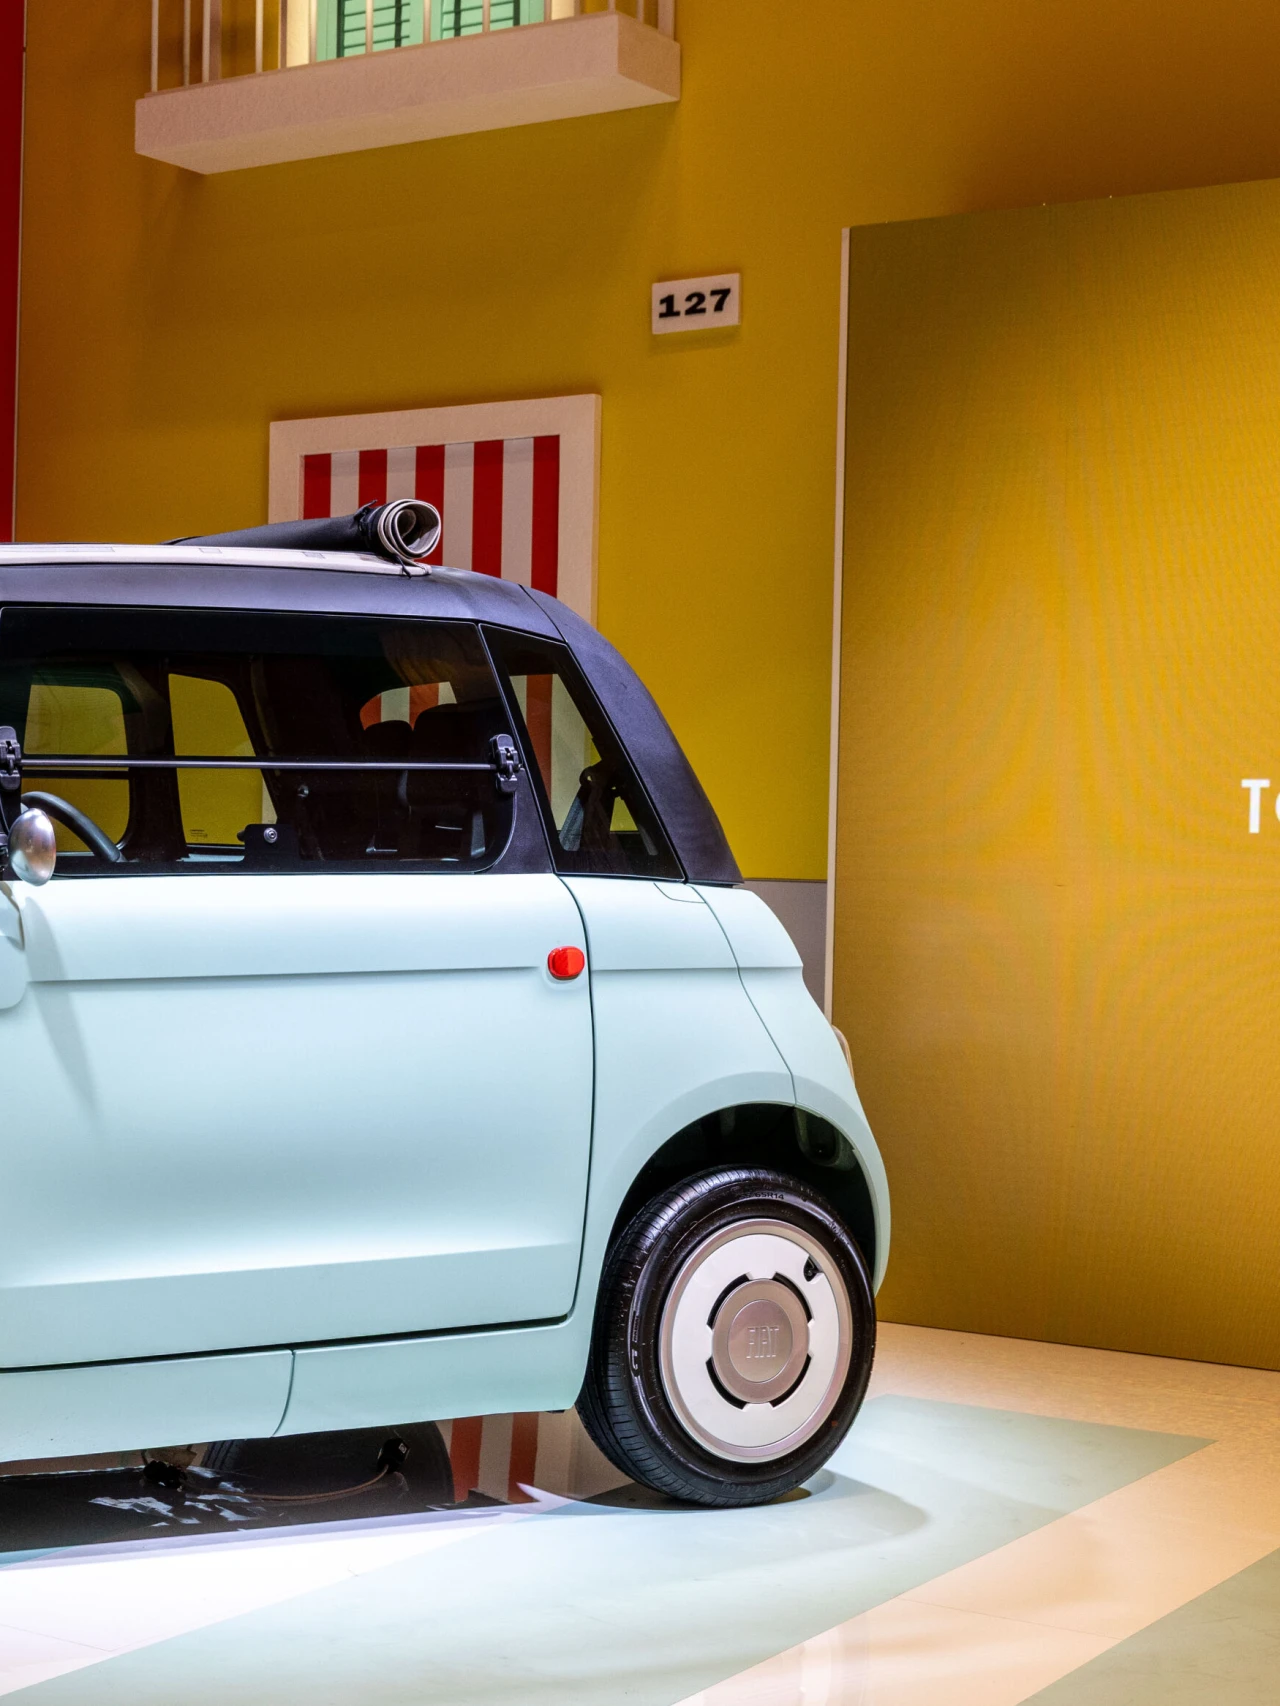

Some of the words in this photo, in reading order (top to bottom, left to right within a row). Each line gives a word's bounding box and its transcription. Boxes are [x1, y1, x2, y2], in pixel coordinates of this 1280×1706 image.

[658, 287, 731, 319] 127
[1241, 779, 1280, 833] T
[746, 1325, 780, 1359] FIAT
